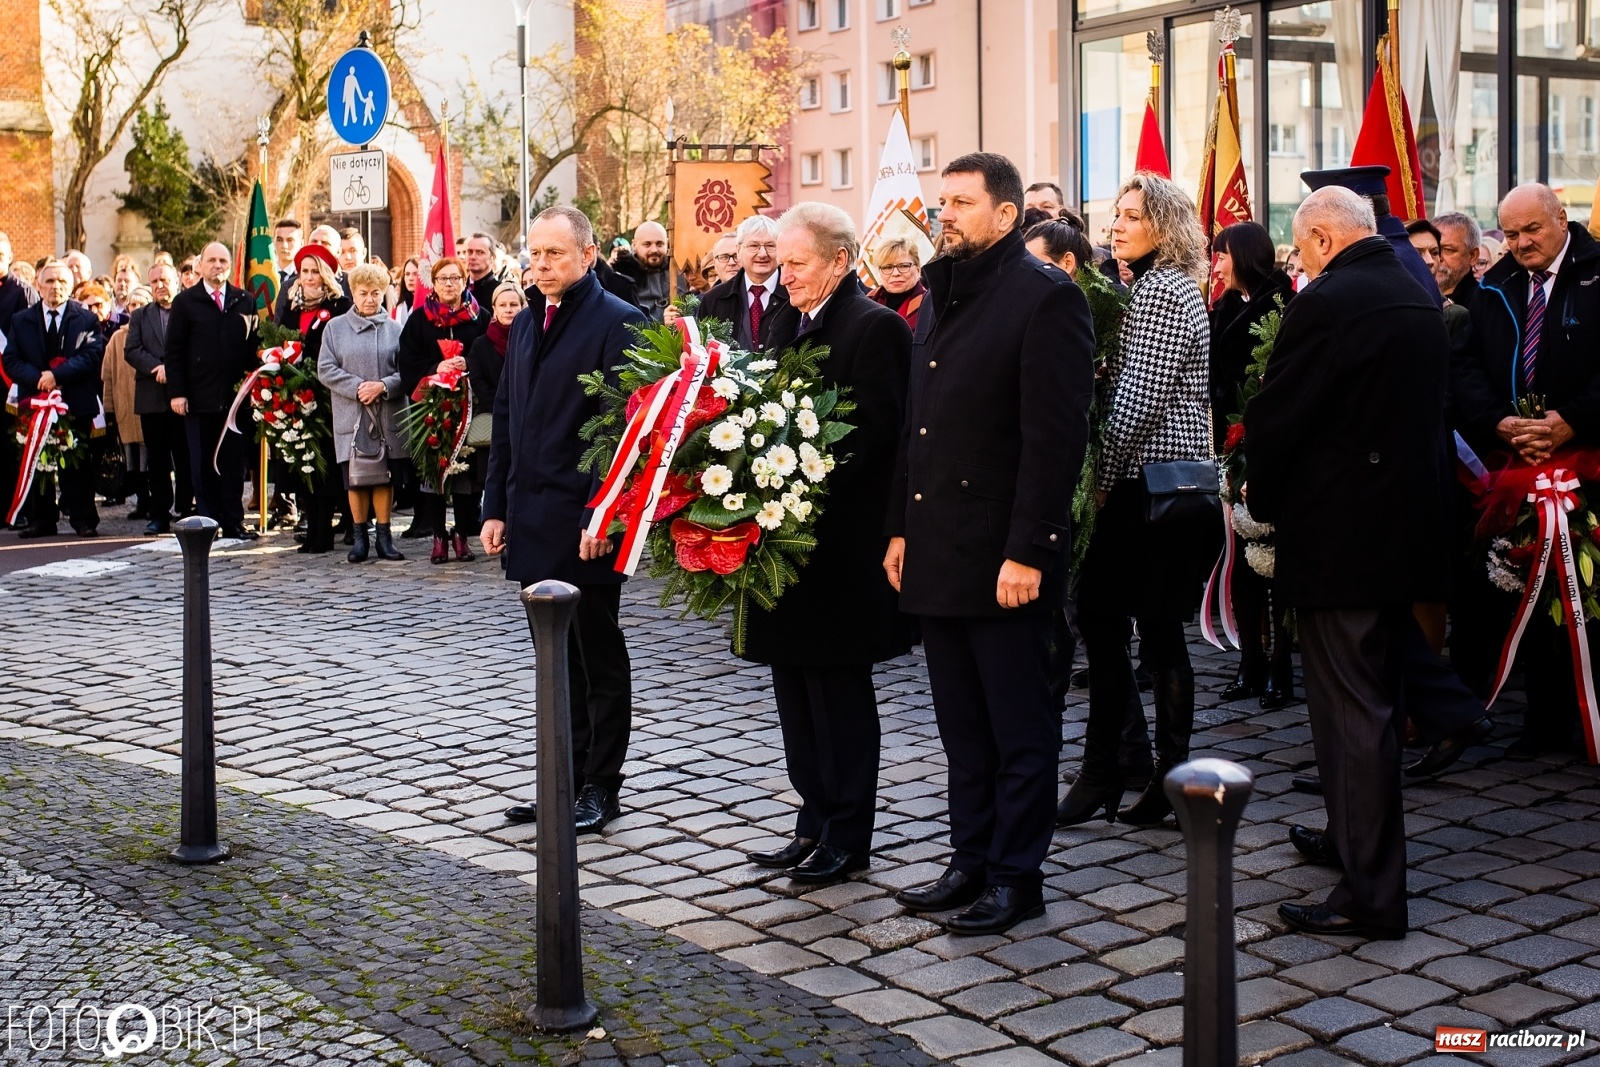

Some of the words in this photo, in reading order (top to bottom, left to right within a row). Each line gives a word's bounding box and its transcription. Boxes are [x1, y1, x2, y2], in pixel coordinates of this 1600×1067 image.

[332, 157, 347, 170] Nie
[350, 156, 381, 171] dotyczy
[1223, 196, 1251, 222] DZ
[650, 396, 691, 470] MIASTA
